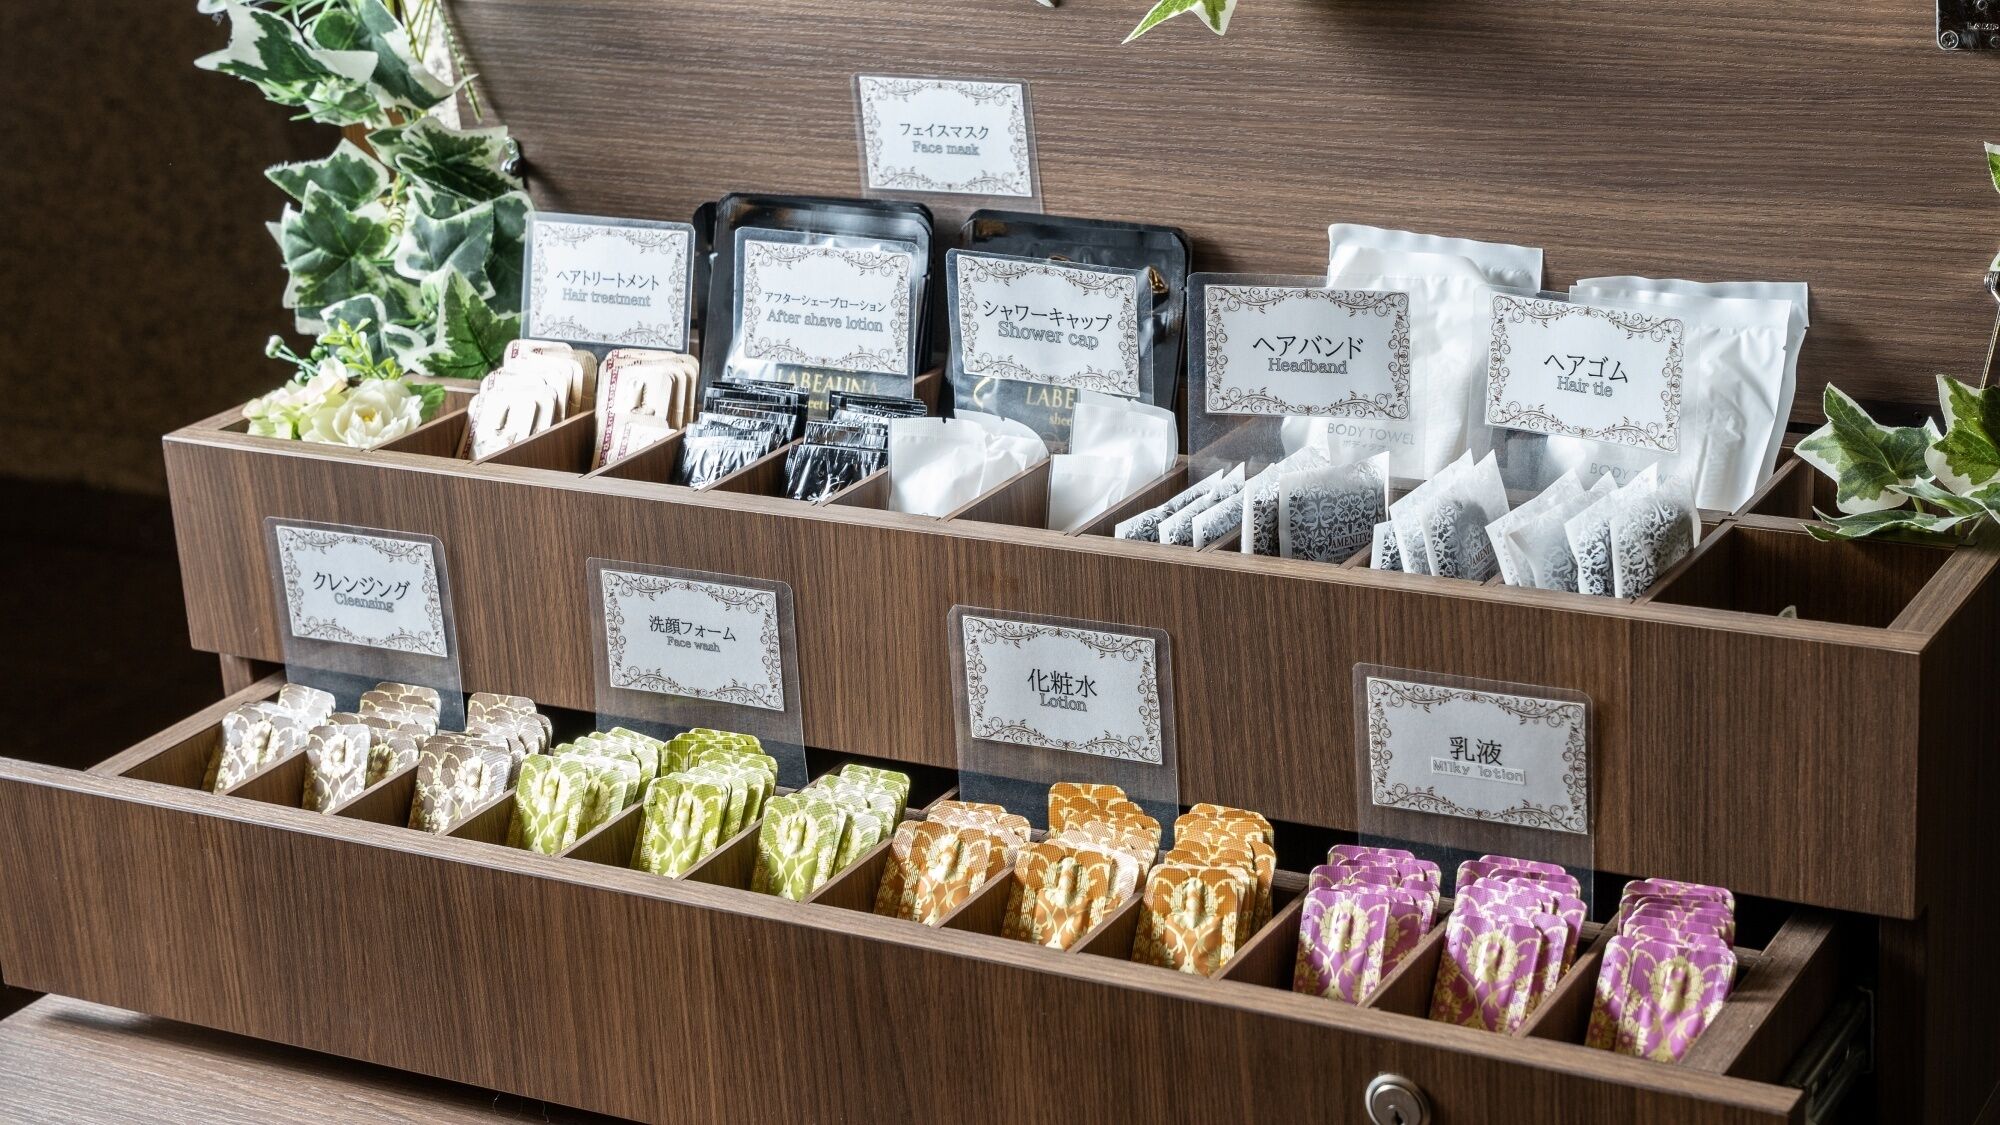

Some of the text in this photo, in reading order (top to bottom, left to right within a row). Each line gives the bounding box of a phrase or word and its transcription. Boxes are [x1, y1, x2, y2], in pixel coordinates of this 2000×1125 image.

[899, 123, 989, 140] フェイスマスク
[912, 140, 980, 156] Face mask
[556, 269, 660, 291] ヘアトリートメント
[562, 287, 652, 307] Hair treatment
[764, 291, 887, 313] アフターシェーブローション
[766, 308, 884, 333] After shave lotion
[982, 300, 1113, 332] シャワーキャップ
[997, 320, 1099, 351] Shower cap
[1252, 334, 1364, 360] ヘアバンド
[1267, 357, 1348, 375] Headband
[1543, 354, 1628, 384] ヘアゴム
[1025, 386, 1076, 410] LABE
[1556, 375, 1613, 398] Hair tie
[1327, 422, 1416, 446] BODY TOWEL
[1590, 462, 1629, 480] BODY
[313, 571, 411, 601] クレンジング
[333, 592, 395, 613] Cleansing
[648, 614, 737, 642] 洗顔フォーム
[666, 635, 721, 653] Face wash
[1027, 668, 1098, 699] 化粧水
[1039, 692, 1088, 713] Lotion
[1449, 736, 1503, 766] 乳液
[1432, 759, 1524, 782] Milky lotion
